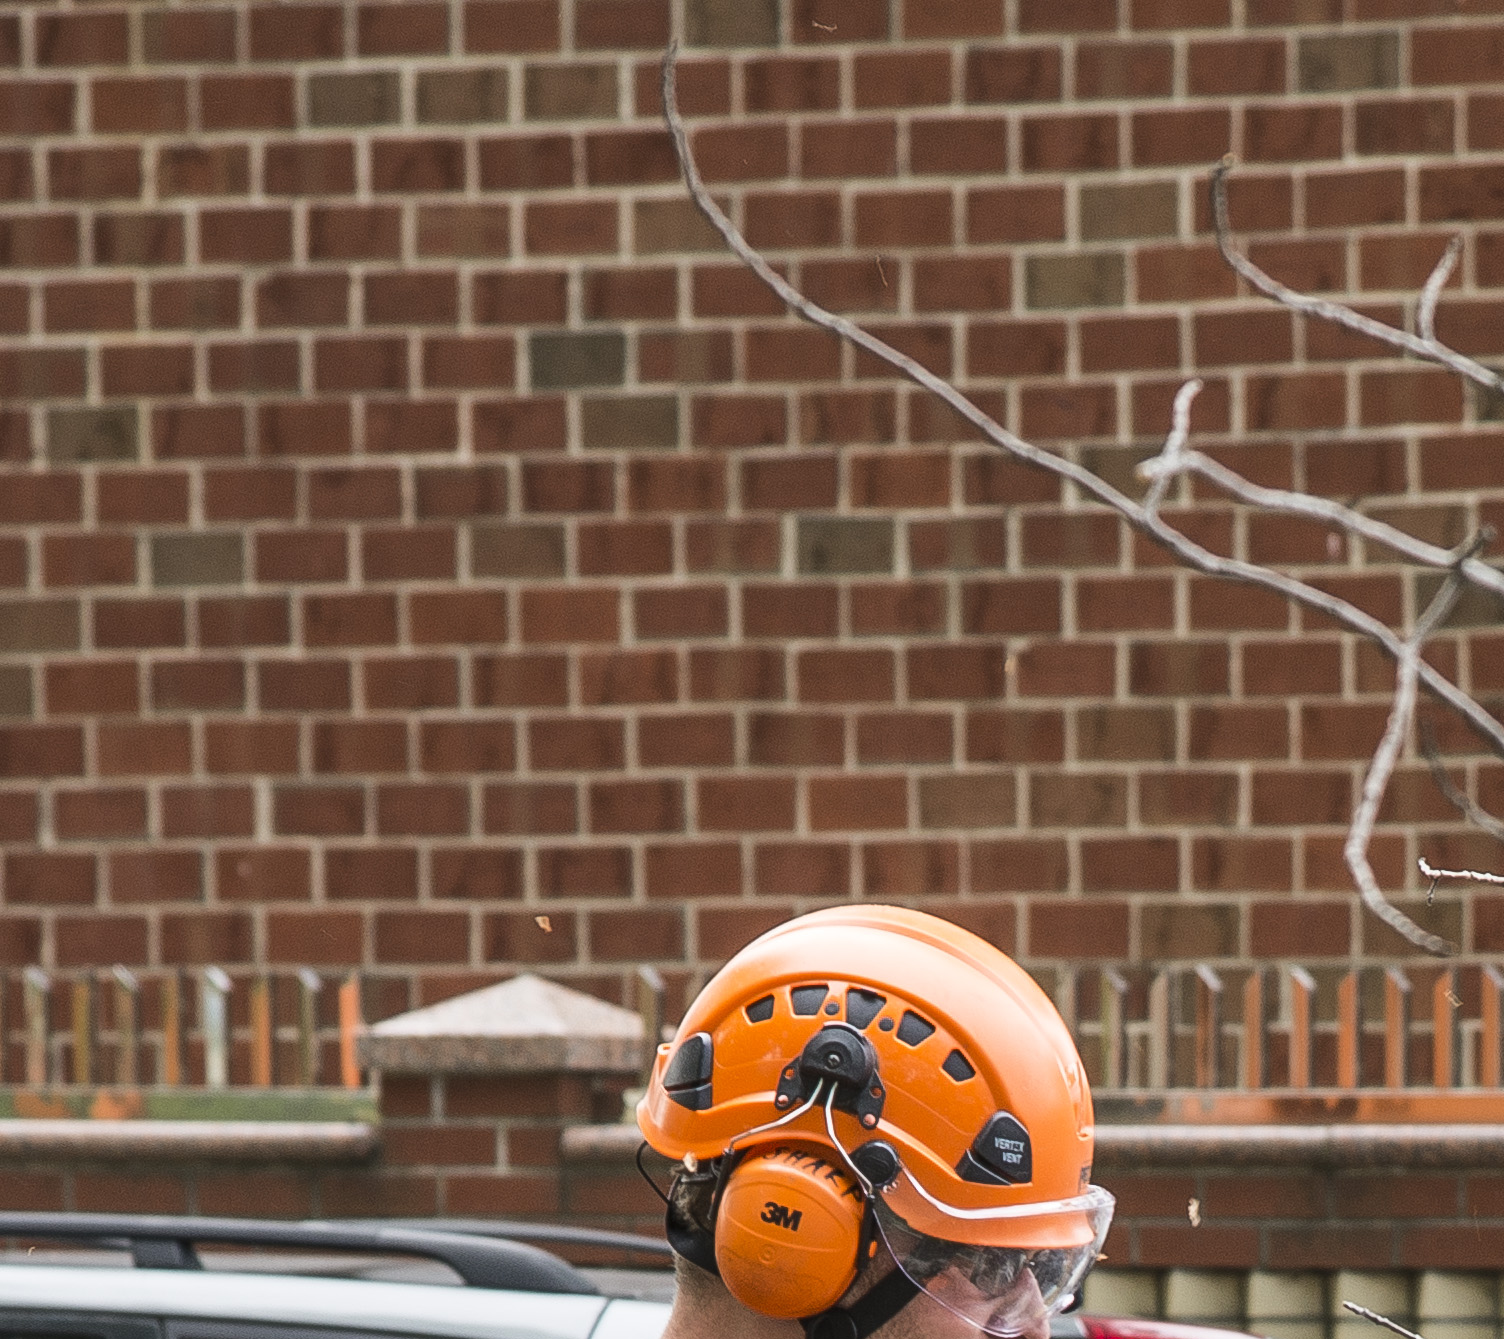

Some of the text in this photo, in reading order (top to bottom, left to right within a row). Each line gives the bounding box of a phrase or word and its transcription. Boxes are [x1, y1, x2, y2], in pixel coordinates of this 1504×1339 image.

[995, 1137, 1025, 1153] VERTEX
[1002, 1152, 1022, 1164] VENT
[760, 1201, 803, 1232] 3M
